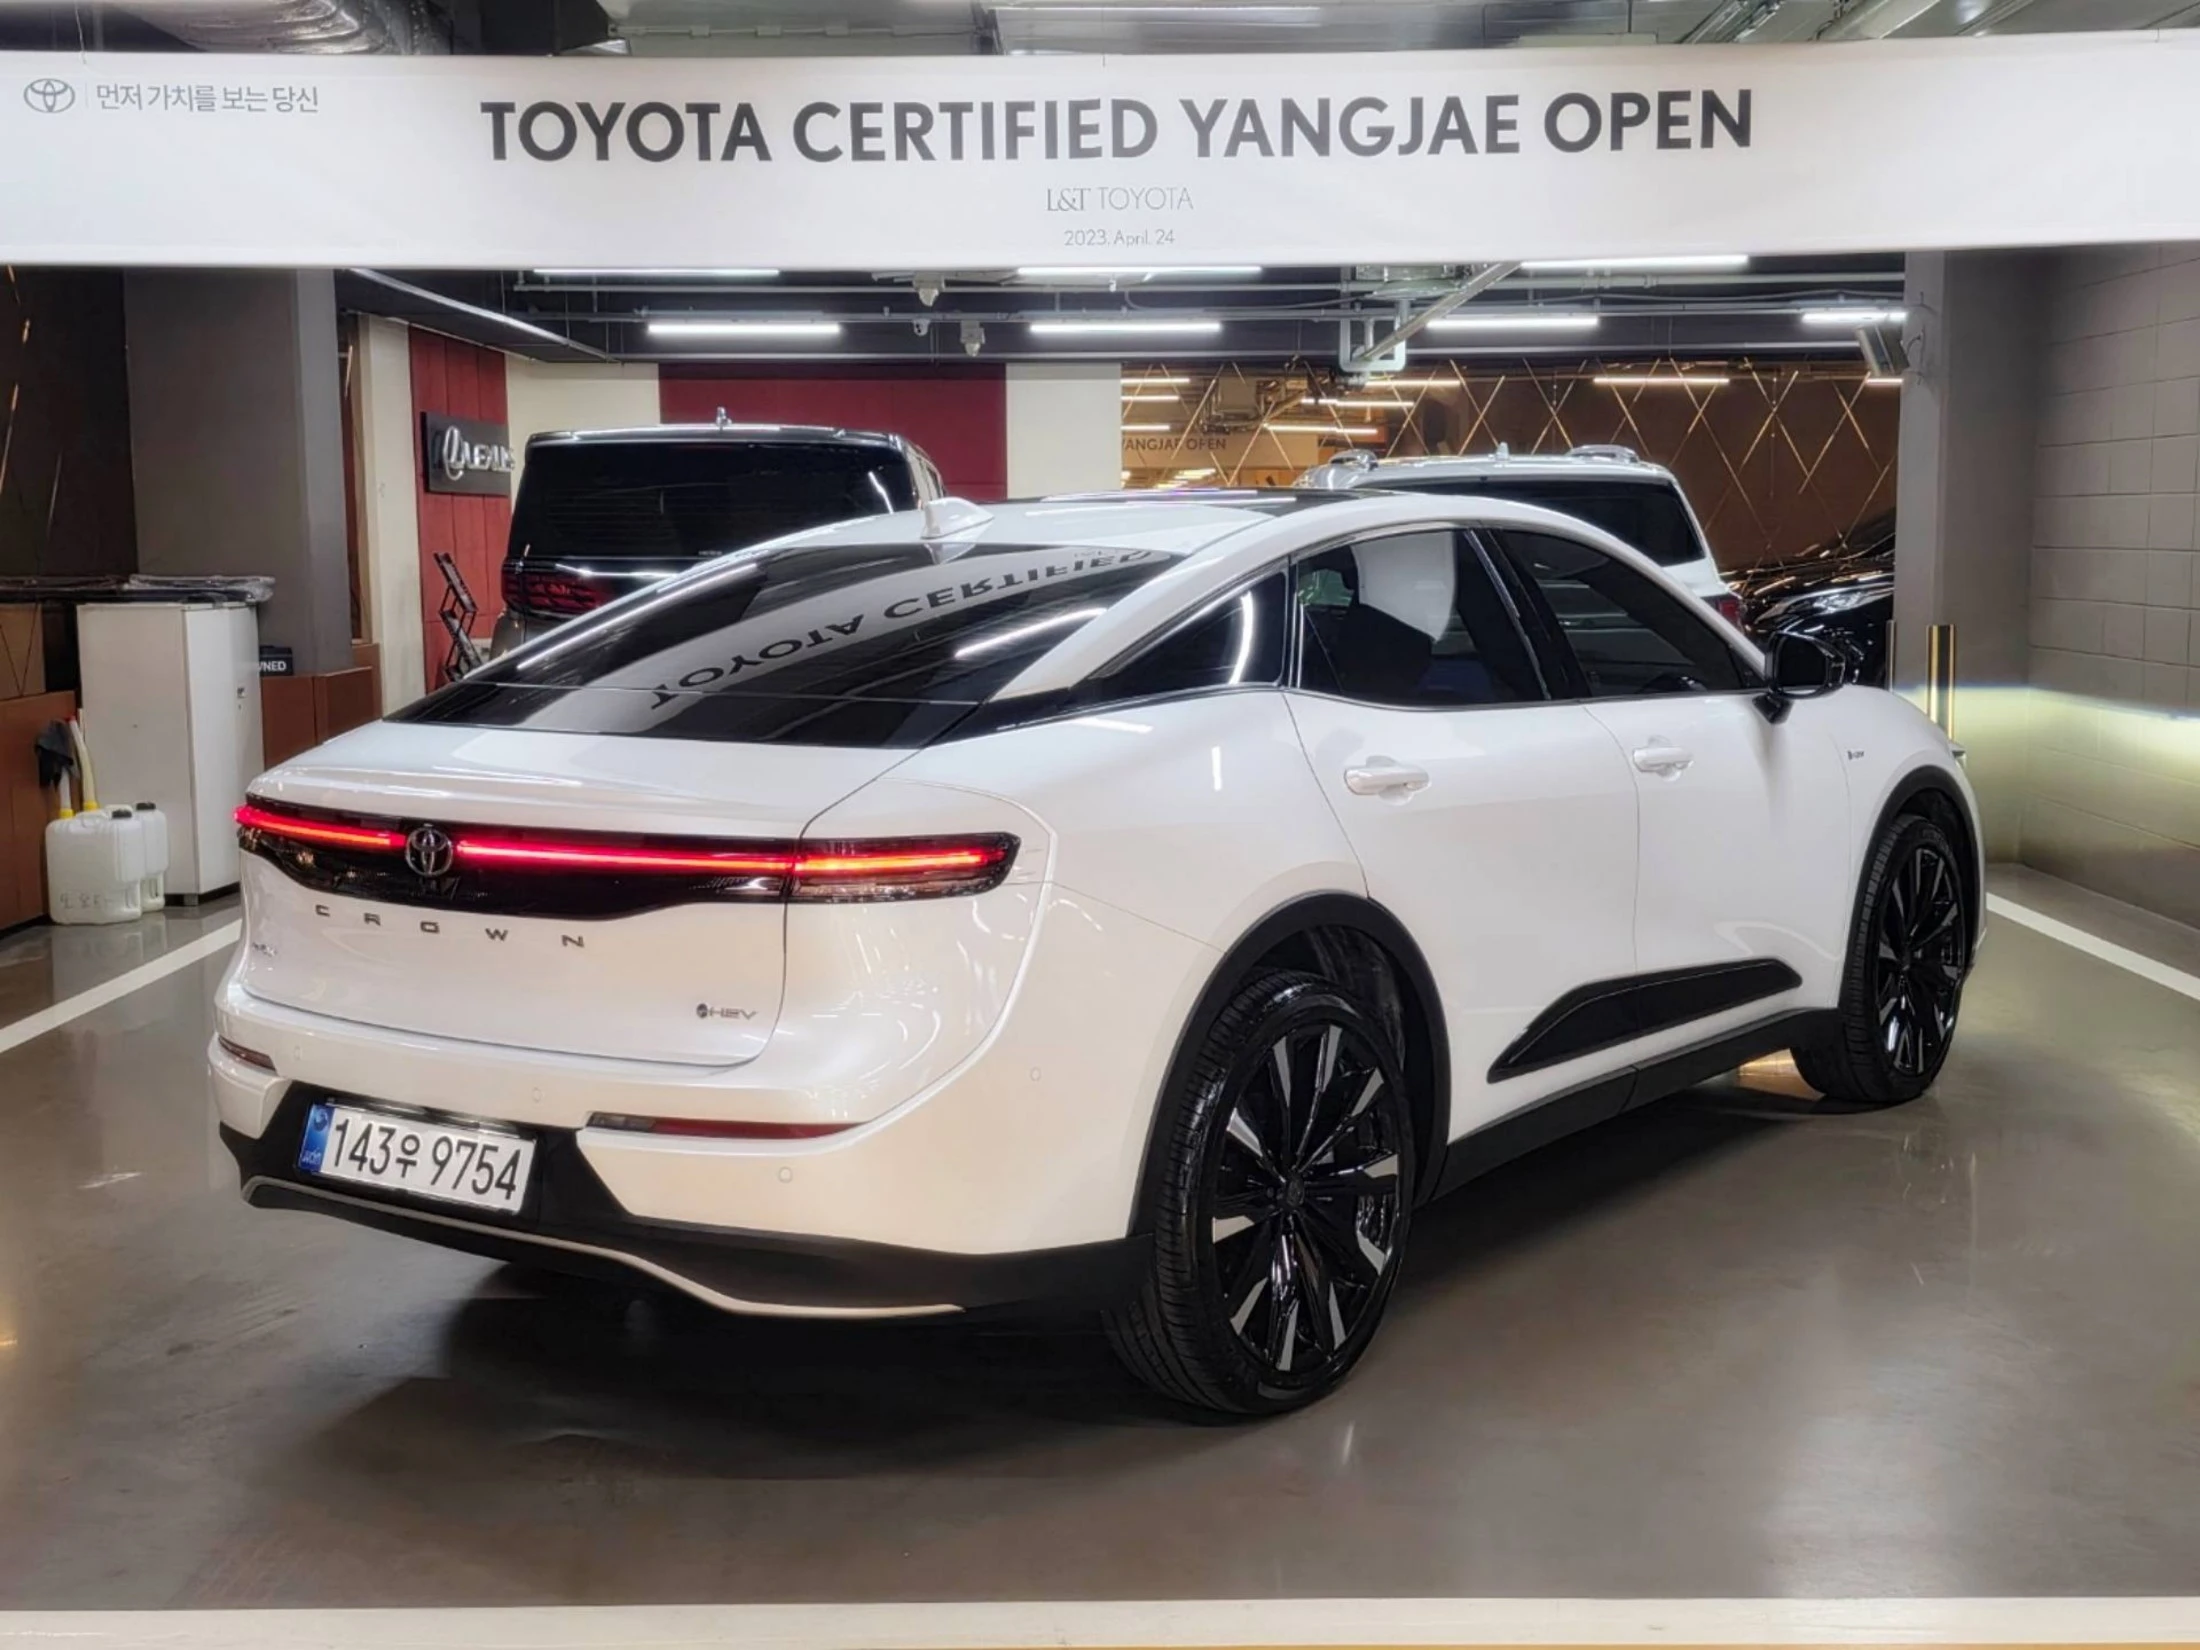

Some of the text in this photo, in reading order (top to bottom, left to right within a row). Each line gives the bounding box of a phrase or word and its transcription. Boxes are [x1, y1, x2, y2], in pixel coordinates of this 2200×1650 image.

[96, 83, 319, 113] 먼저 가치를 보는 당신
[480, 88, 1752, 163] TOYOTA CERTIFIED YANGJAE OPEN
[1046, 185, 1194, 212] L&T TOYOTA
[1063, 229, 1110, 247] 2023.
[1155, 228, 1175, 245] 24
[315, 903, 585, 948] CROWN
[333, 1117, 522, 1201] 143우 9754
